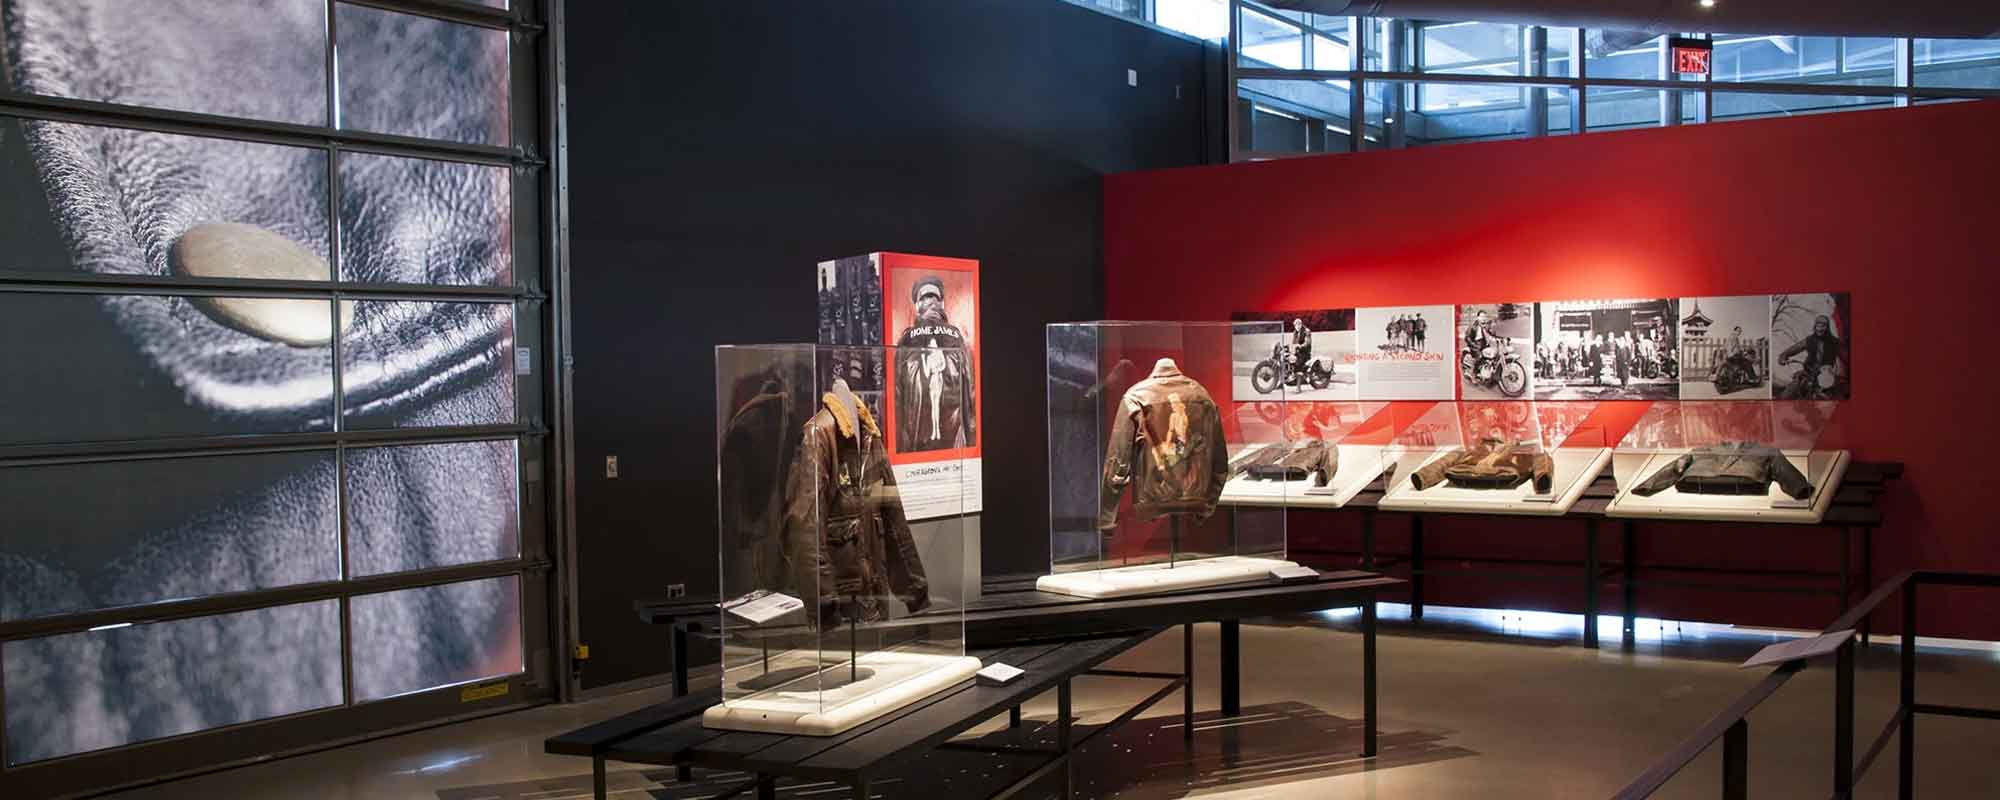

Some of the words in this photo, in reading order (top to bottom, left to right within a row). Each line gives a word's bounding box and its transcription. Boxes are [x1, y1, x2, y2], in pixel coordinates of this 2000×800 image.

[1679, 50, 1705, 72] EXIT
[910, 326, 933, 338] HOME
[933, 326, 960, 338] JAMES
[1391, 352, 1421, 361] SECOND
[1423, 352, 1444, 361] SKIN
